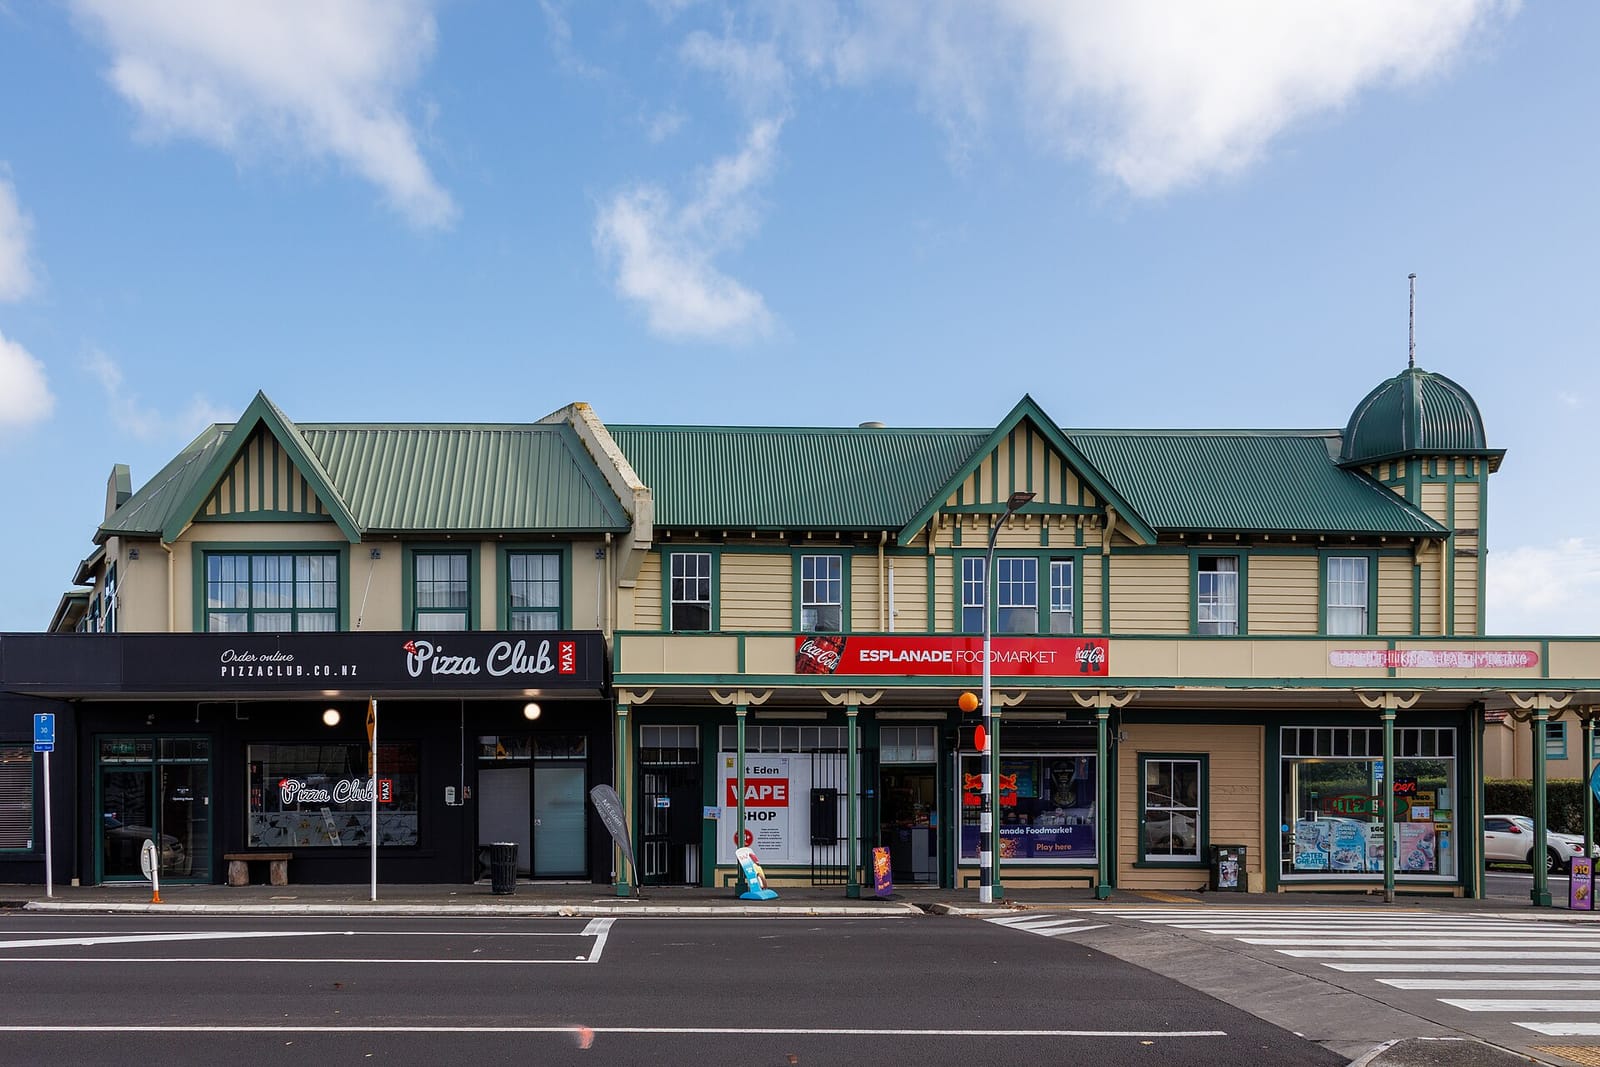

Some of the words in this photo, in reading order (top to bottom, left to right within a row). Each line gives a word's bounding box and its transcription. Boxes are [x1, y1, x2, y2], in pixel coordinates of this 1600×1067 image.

[220, 649, 258, 663] Order
[259, 650, 294, 662] online
[407, 640, 481, 678] Pizza
[486, 639, 555, 677] Club
[562, 644, 573, 671] MAX
[859, 650, 953, 662] ESPLANADE
[956, 650, 1057, 663] FOODMARKET
[221, 665, 357, 677] PIZZACLUB.CO.NZ
[753, 766, 779, 774] Eden
[281, 779, 331, 804] Pizza
[332, 778, 378, 804] Club
[731, 785, 786, 800] VAPE
[1393, 782, 1417, 792] pen
[744, 811, 777, 821] HOP
[1025, 827, 1073, 835] Foodmarket
[1036, 843, 1053, 852] Play
[1573, 864, 1589, 875] $10
